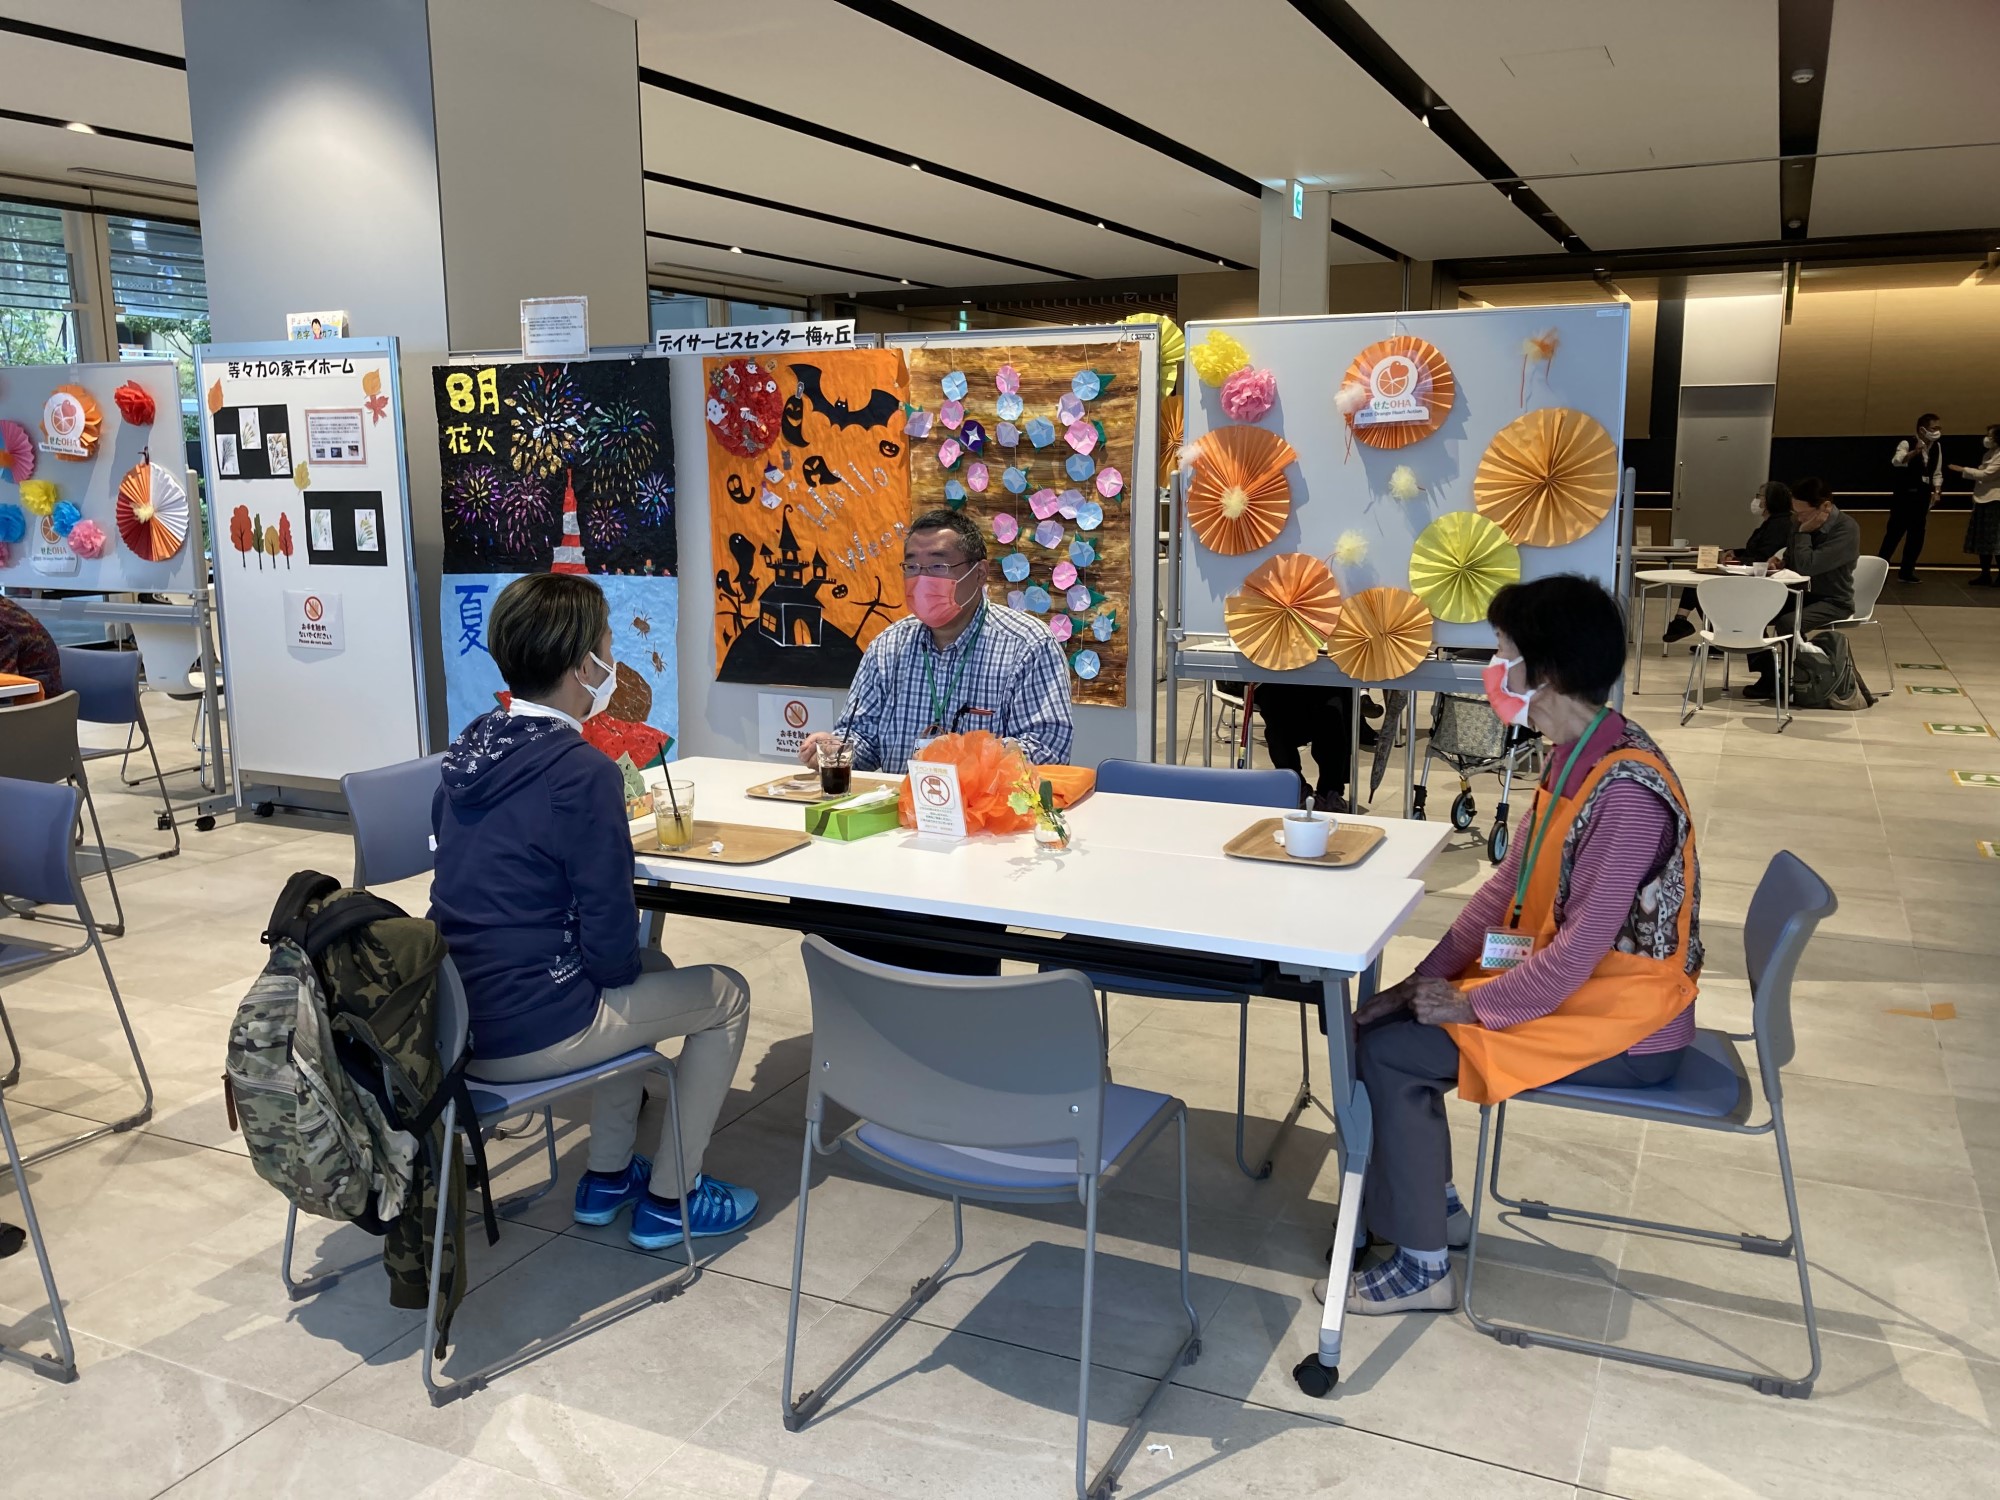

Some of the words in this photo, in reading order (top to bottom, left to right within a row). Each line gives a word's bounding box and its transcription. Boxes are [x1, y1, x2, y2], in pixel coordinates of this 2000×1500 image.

[228, 358, 355, 379] 等々力の家デイホーム
[445, 367, 500, 415] 8月
[1373, 399, 1412, 409] せたOHA
[445, 422, 497, 456] 花火
[454, 584, 490, 657] 夏
